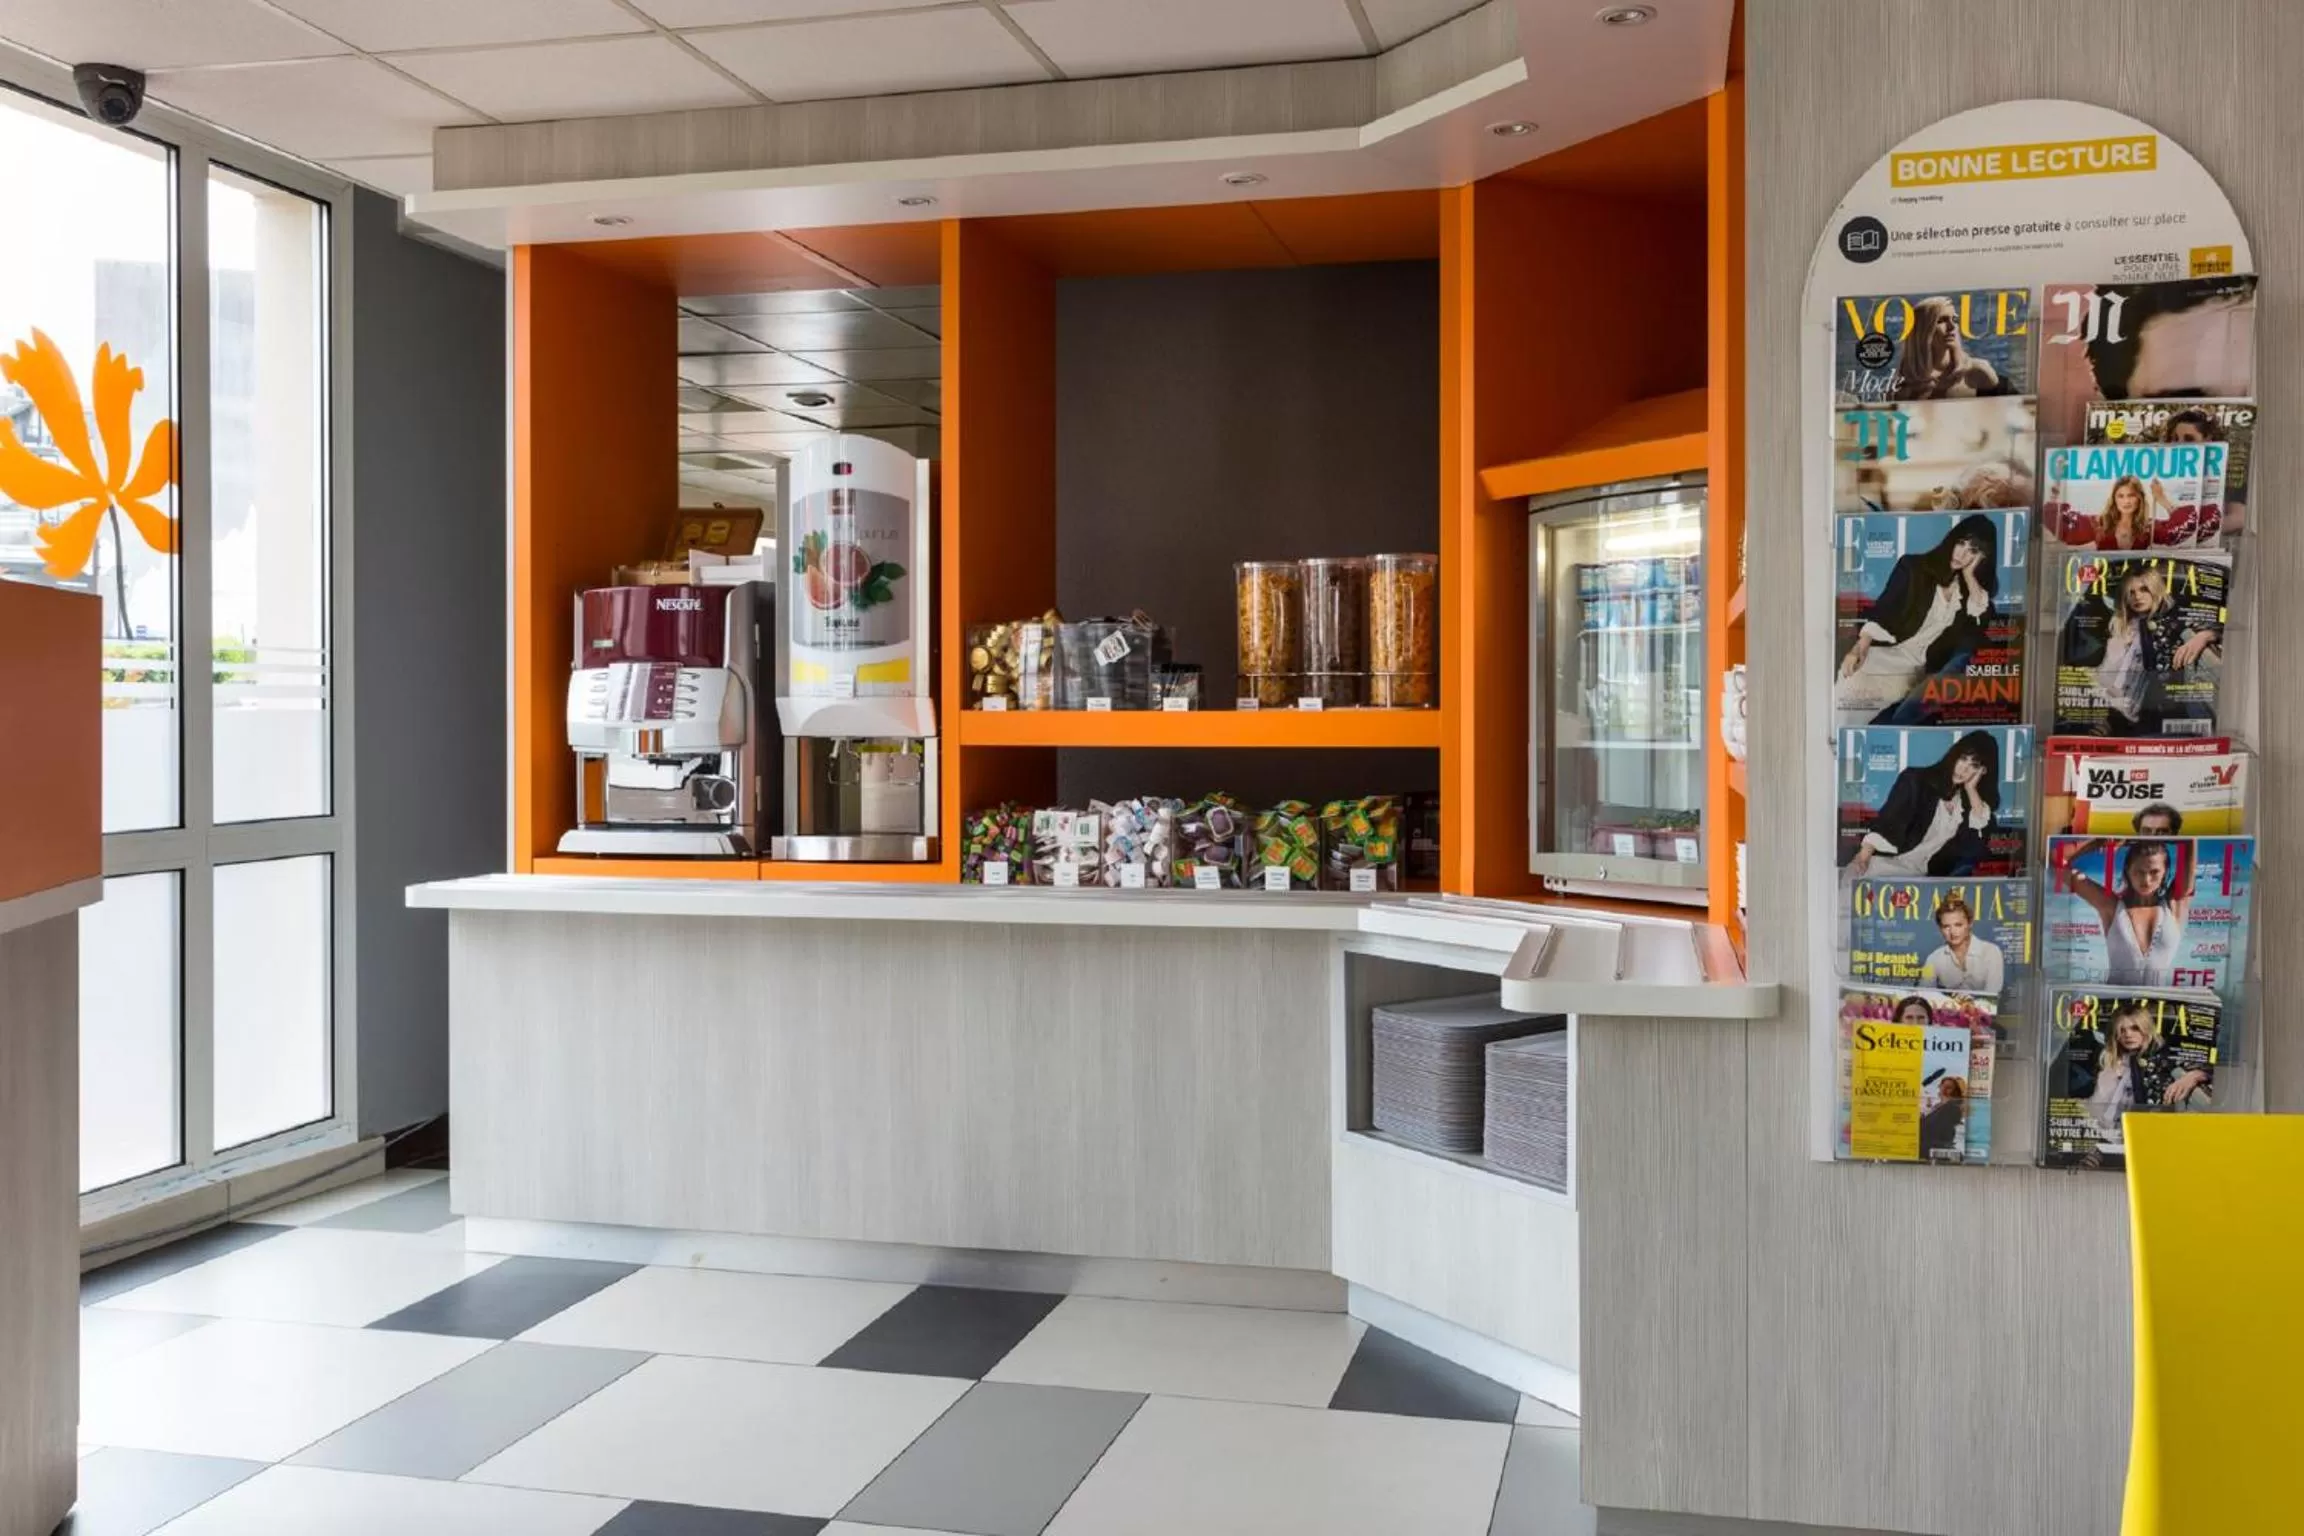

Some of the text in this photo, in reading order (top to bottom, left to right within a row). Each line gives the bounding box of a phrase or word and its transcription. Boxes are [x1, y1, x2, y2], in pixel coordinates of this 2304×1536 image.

[1897, 142, 2150, 181] BONNE LECTURE
[1890, 230, 1914, 242] Une
[1916, 226, 1969, 241] sélection
[1971, 225, 2011, 240] presse
[2013, 220, 2062, 237] gratuite
[2075, 215, 2130, 230] consulter
[2133, 214, 2151, 225] sur
[2154, 212, 2188, 225] place
[2124, 260, 2181, 273] POUR UNE
[1844, 290, 2029, 343] VOUE
[2089, 403, 2171, 430] marie
[2050, 445, 2200, 481] GLAMOUR
[1843, 511, 2027, 573] ELE
[2065, 554, 2200, 597] GRIA
[1966, 664, 2021, 677] ISABELLE
[1921, 677, 2021, 705] ADJANI
[2058, 697, 2089, 708] VOTRE
[1845, 728, 2029, 783] ELE
[2087, 767, 2130, 783] VAL
[2086, 783, 2166, 800] D'OISE
[2055, 992, 2190, 1037] GRIA
[1855, 1023, 1964, 1053] Sélection
[2049, 1127, 2081, 1139] VOTRE
